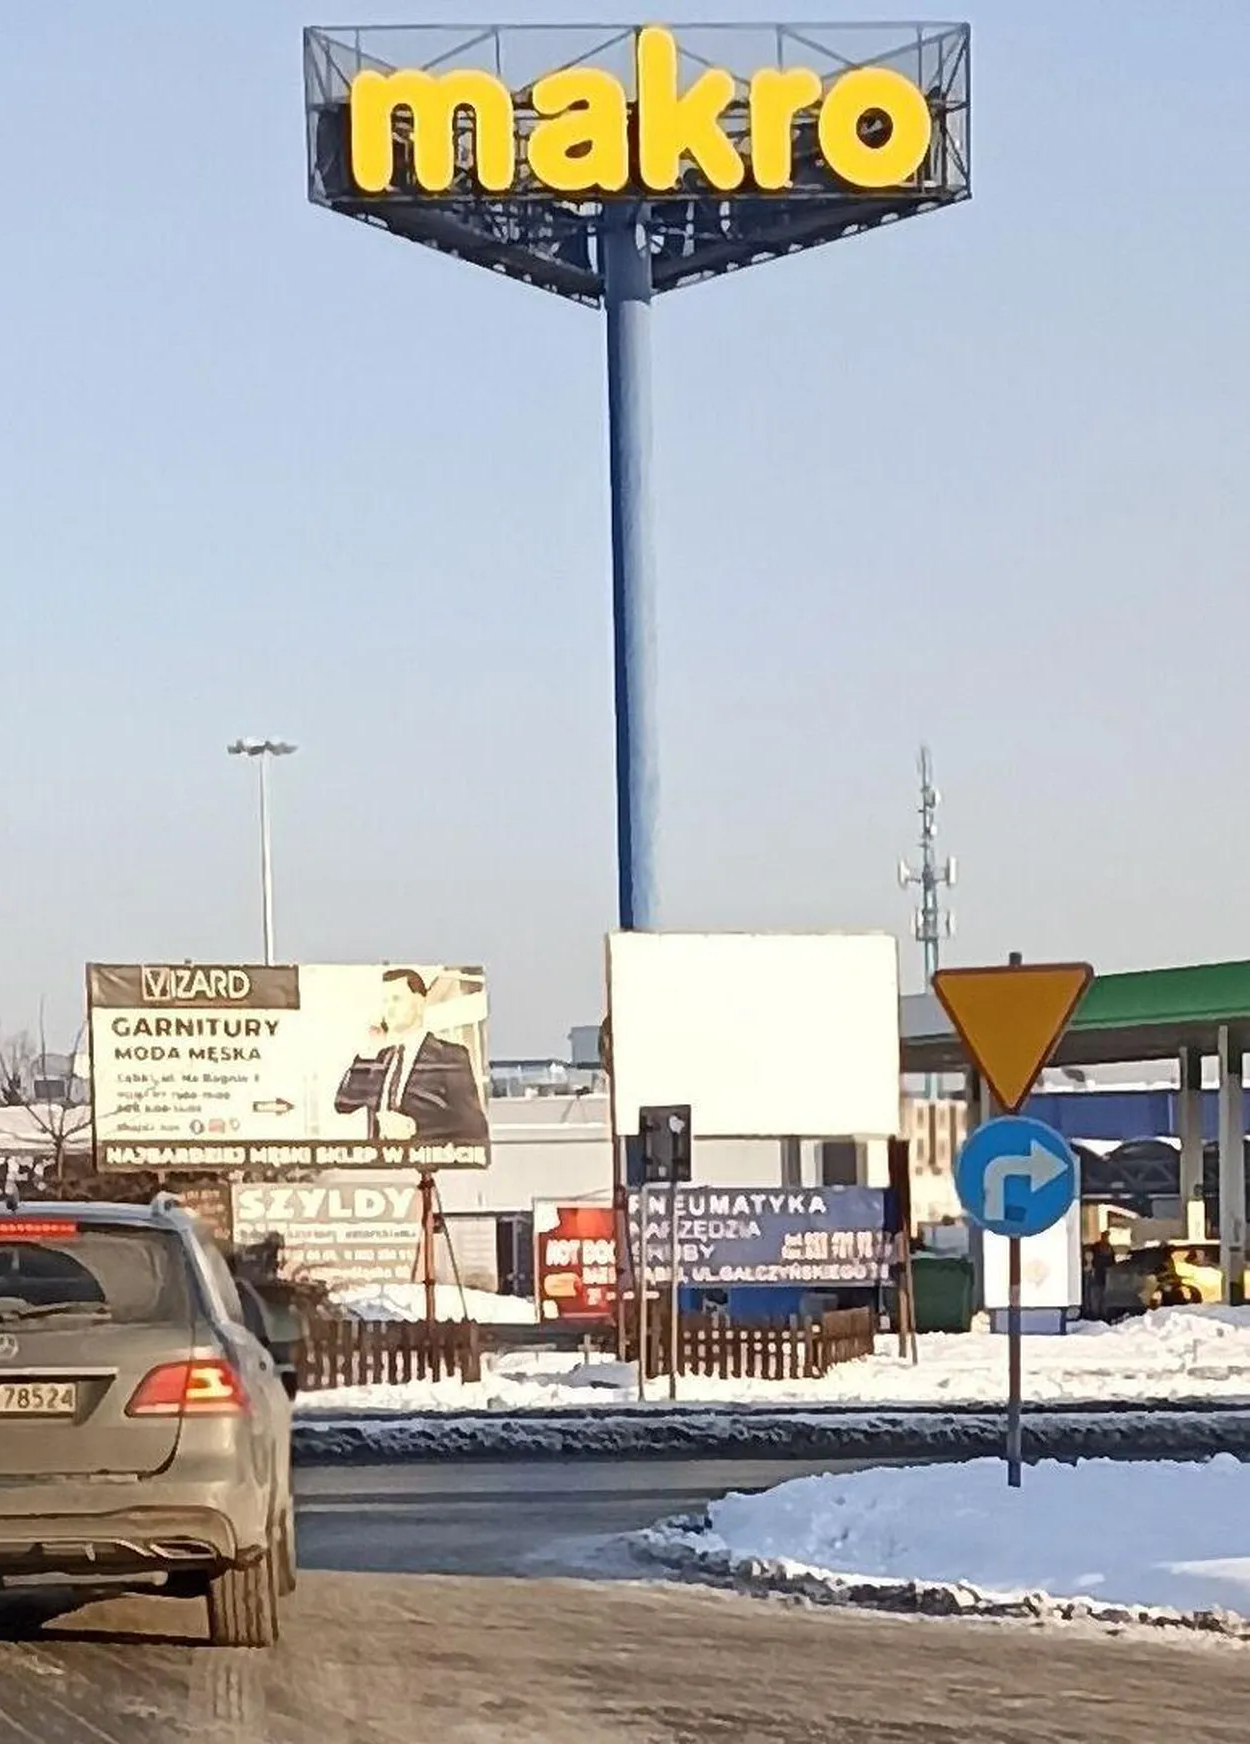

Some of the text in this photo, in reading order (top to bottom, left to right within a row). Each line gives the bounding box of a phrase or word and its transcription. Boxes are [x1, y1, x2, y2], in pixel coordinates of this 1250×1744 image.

[351, 24, 932, 192] makro
[142, 967, 251, 1000] VIZARD
[111, 1016, 280, 1038] GARNITURY
[114, 1046, 262, 1064] MODA MĘSKA
[315, 1146, 379, 1164] SKLEP
[382, 1146, 404, 1164] W
[238, 1187, 416, 1219] SZYLDY
[546, 1239, 581, 1266] HOT
[3, 1386, 74, 1410] 78524
